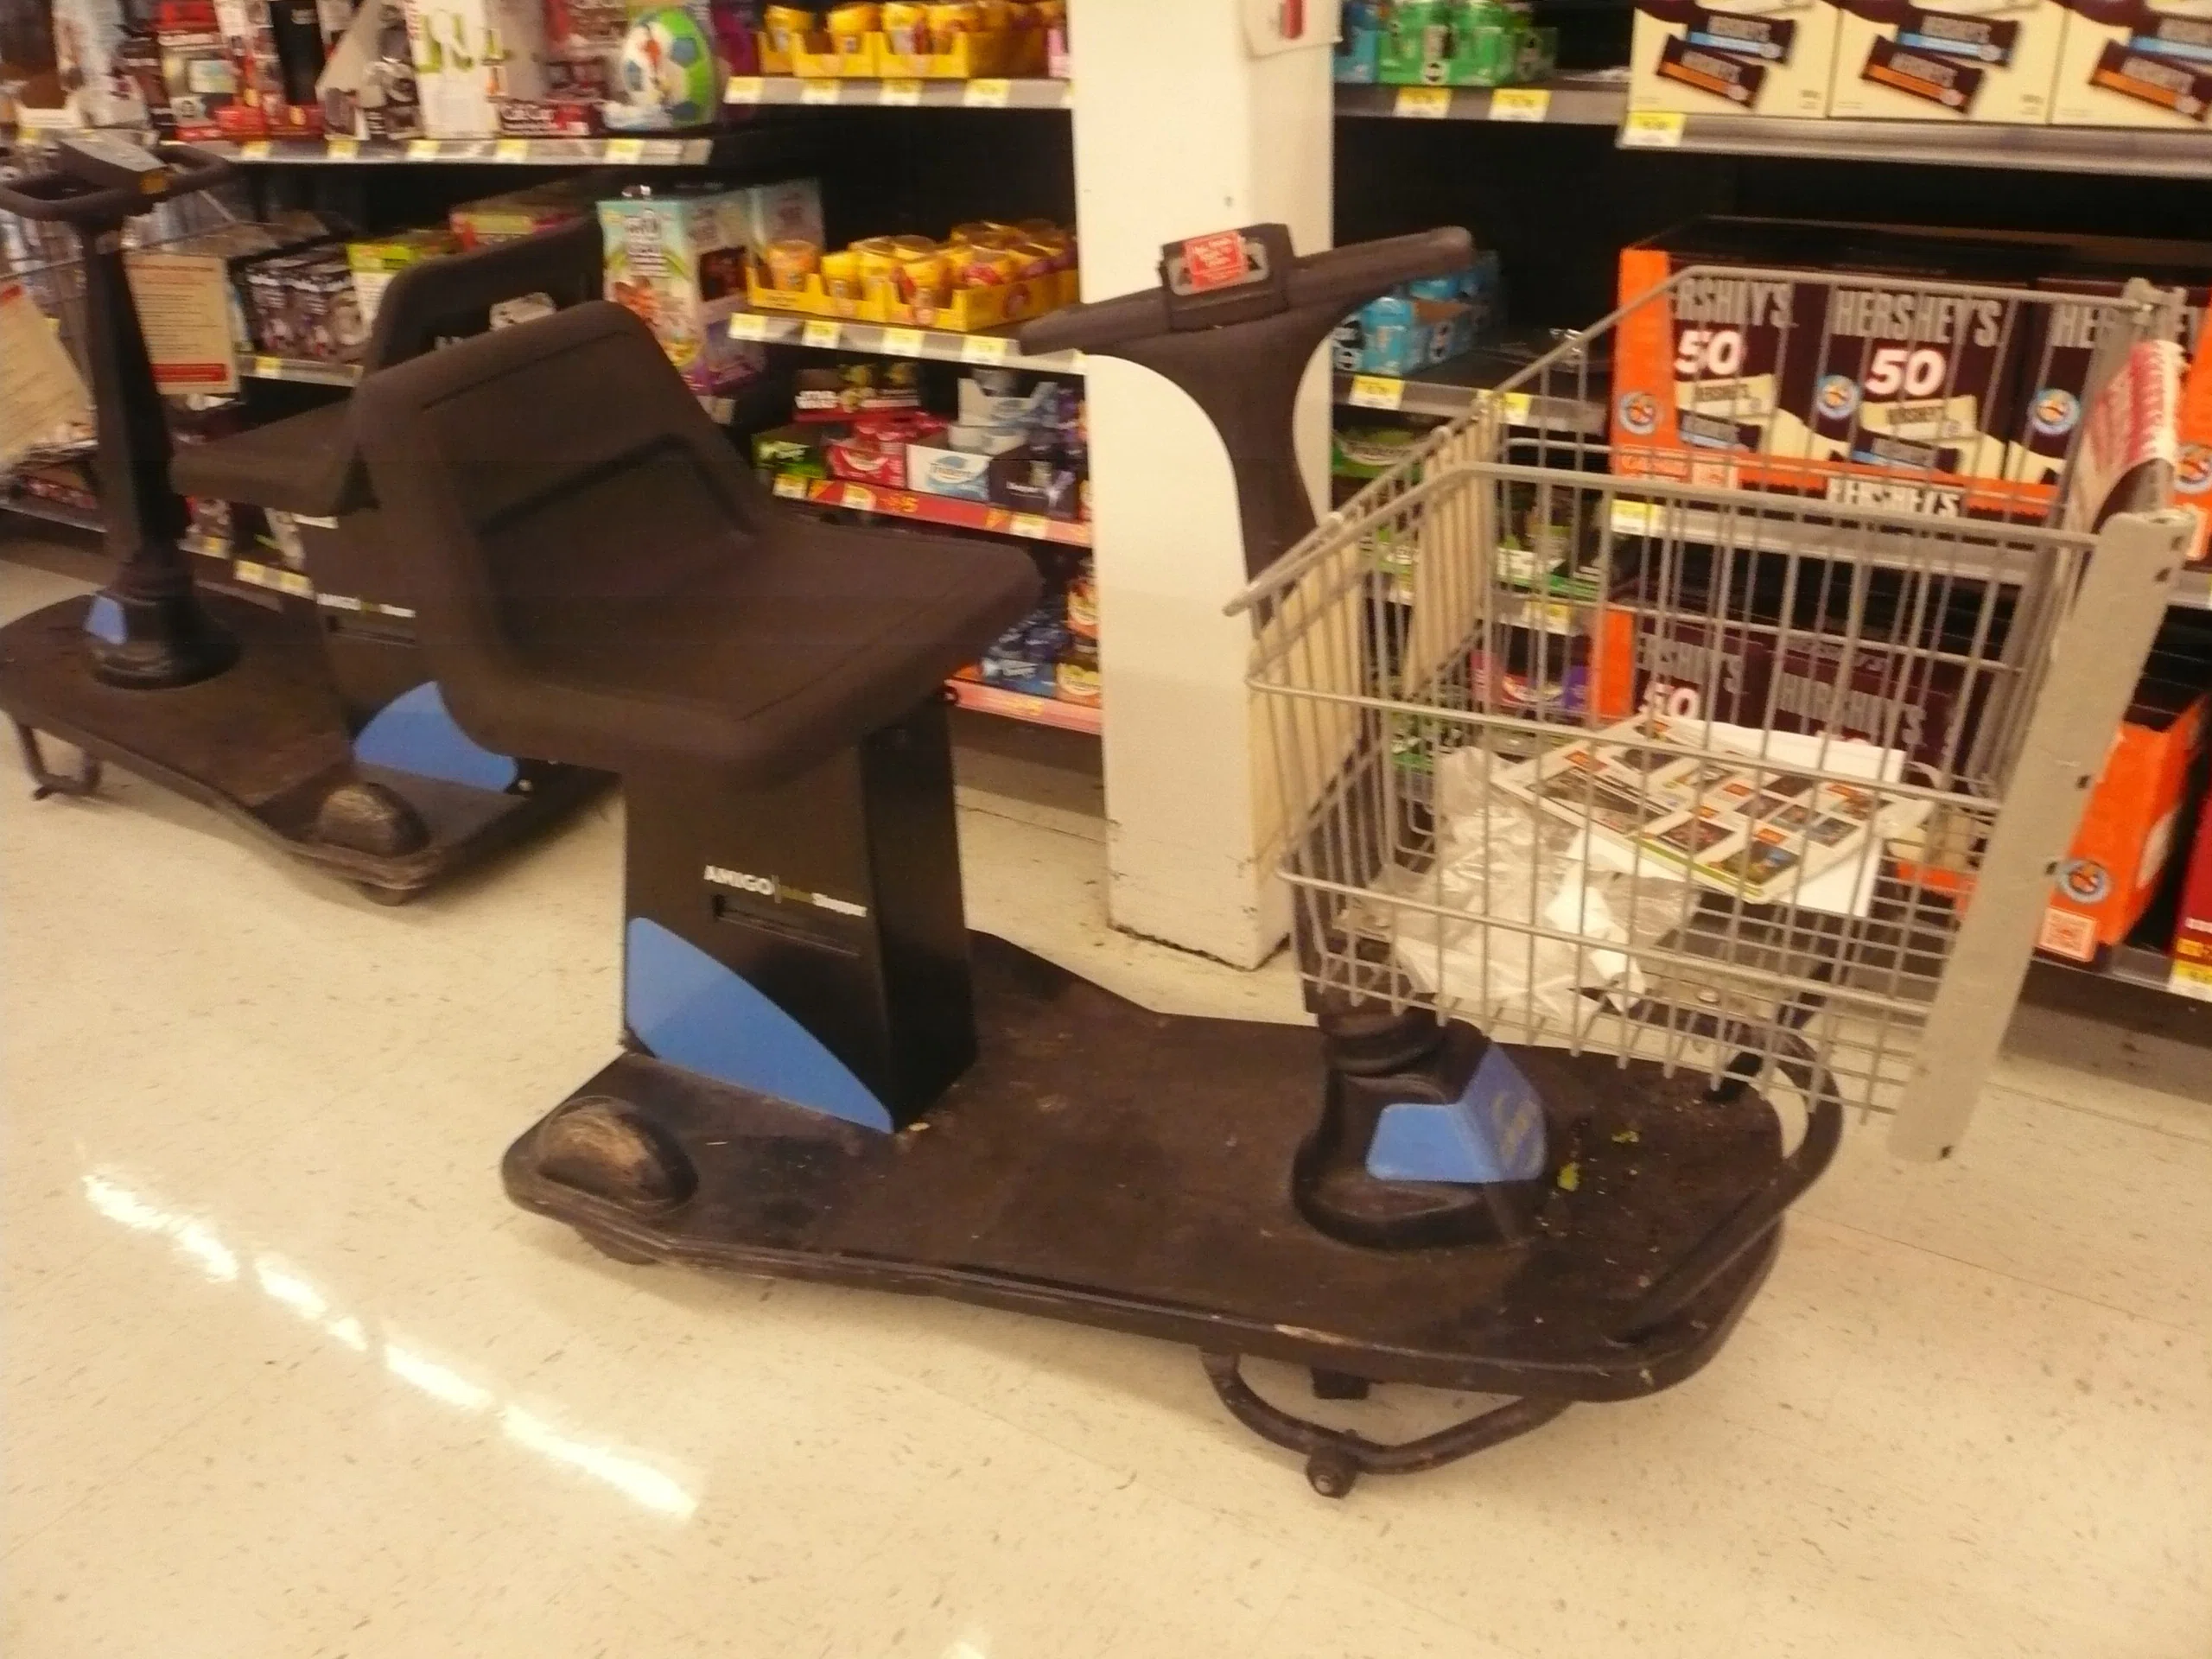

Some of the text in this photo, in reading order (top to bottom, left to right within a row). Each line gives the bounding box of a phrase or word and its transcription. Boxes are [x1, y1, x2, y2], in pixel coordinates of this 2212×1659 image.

[1828, 289, 2004, 347] HERSHEY'S
[1675, 329, 1744, 375] 50
[1865, 347, 1947, 397] 50
